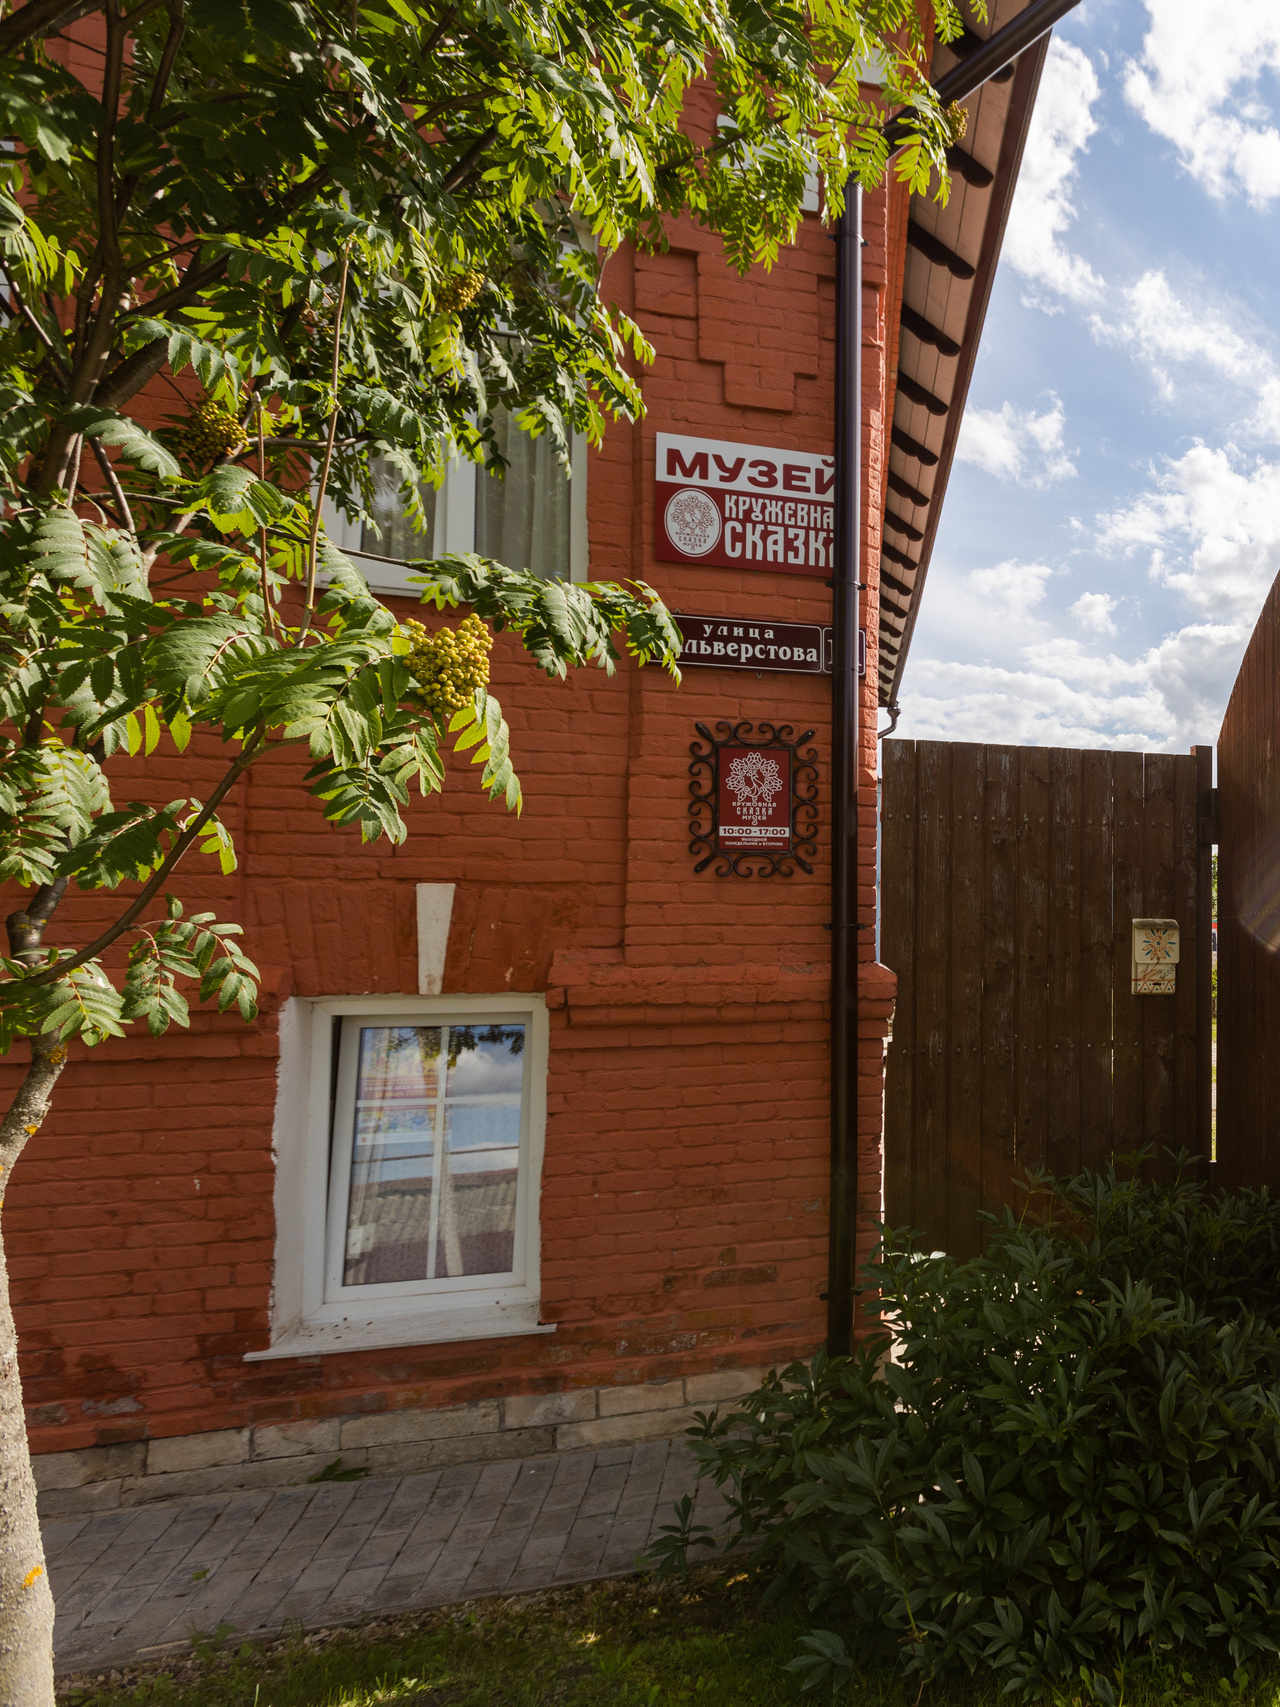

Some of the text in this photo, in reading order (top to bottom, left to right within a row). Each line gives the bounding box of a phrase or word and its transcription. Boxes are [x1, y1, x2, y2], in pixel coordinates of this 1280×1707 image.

[666, 447, 835, 496] МУЗЕЙ
[724, 494, 834, 530] КРУЖЕВНА
[702, 624, 775, 641] улица
[679, 638, 818, 663] льверстова
[736, 807, 773, 815] СКАЗКА
